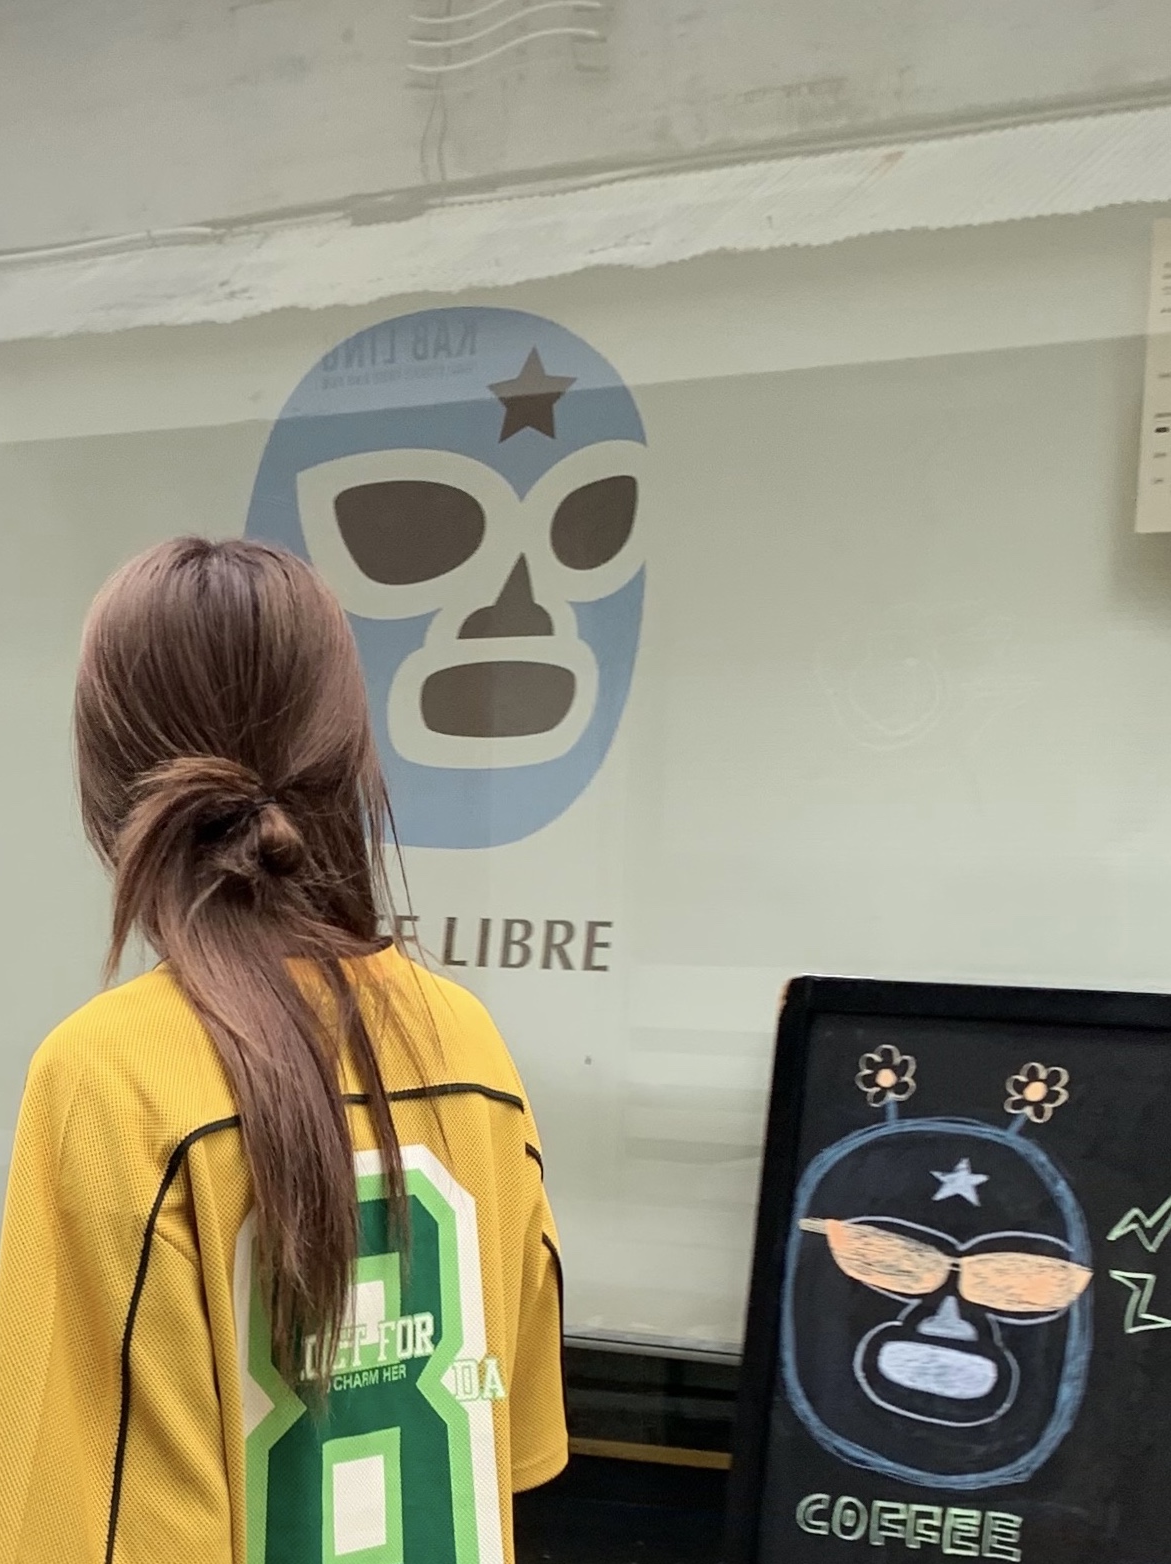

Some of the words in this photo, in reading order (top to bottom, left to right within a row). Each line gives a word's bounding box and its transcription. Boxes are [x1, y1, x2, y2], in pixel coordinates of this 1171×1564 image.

[443, 916, 614, 972] LIBRE
[377, 1312, 435, 1364] FOR
[332, 1368, 380, 1392] CHARM
[383, 1365, 407, 1384] HER
[795, 1493, 1023, 1562] COFFEE
